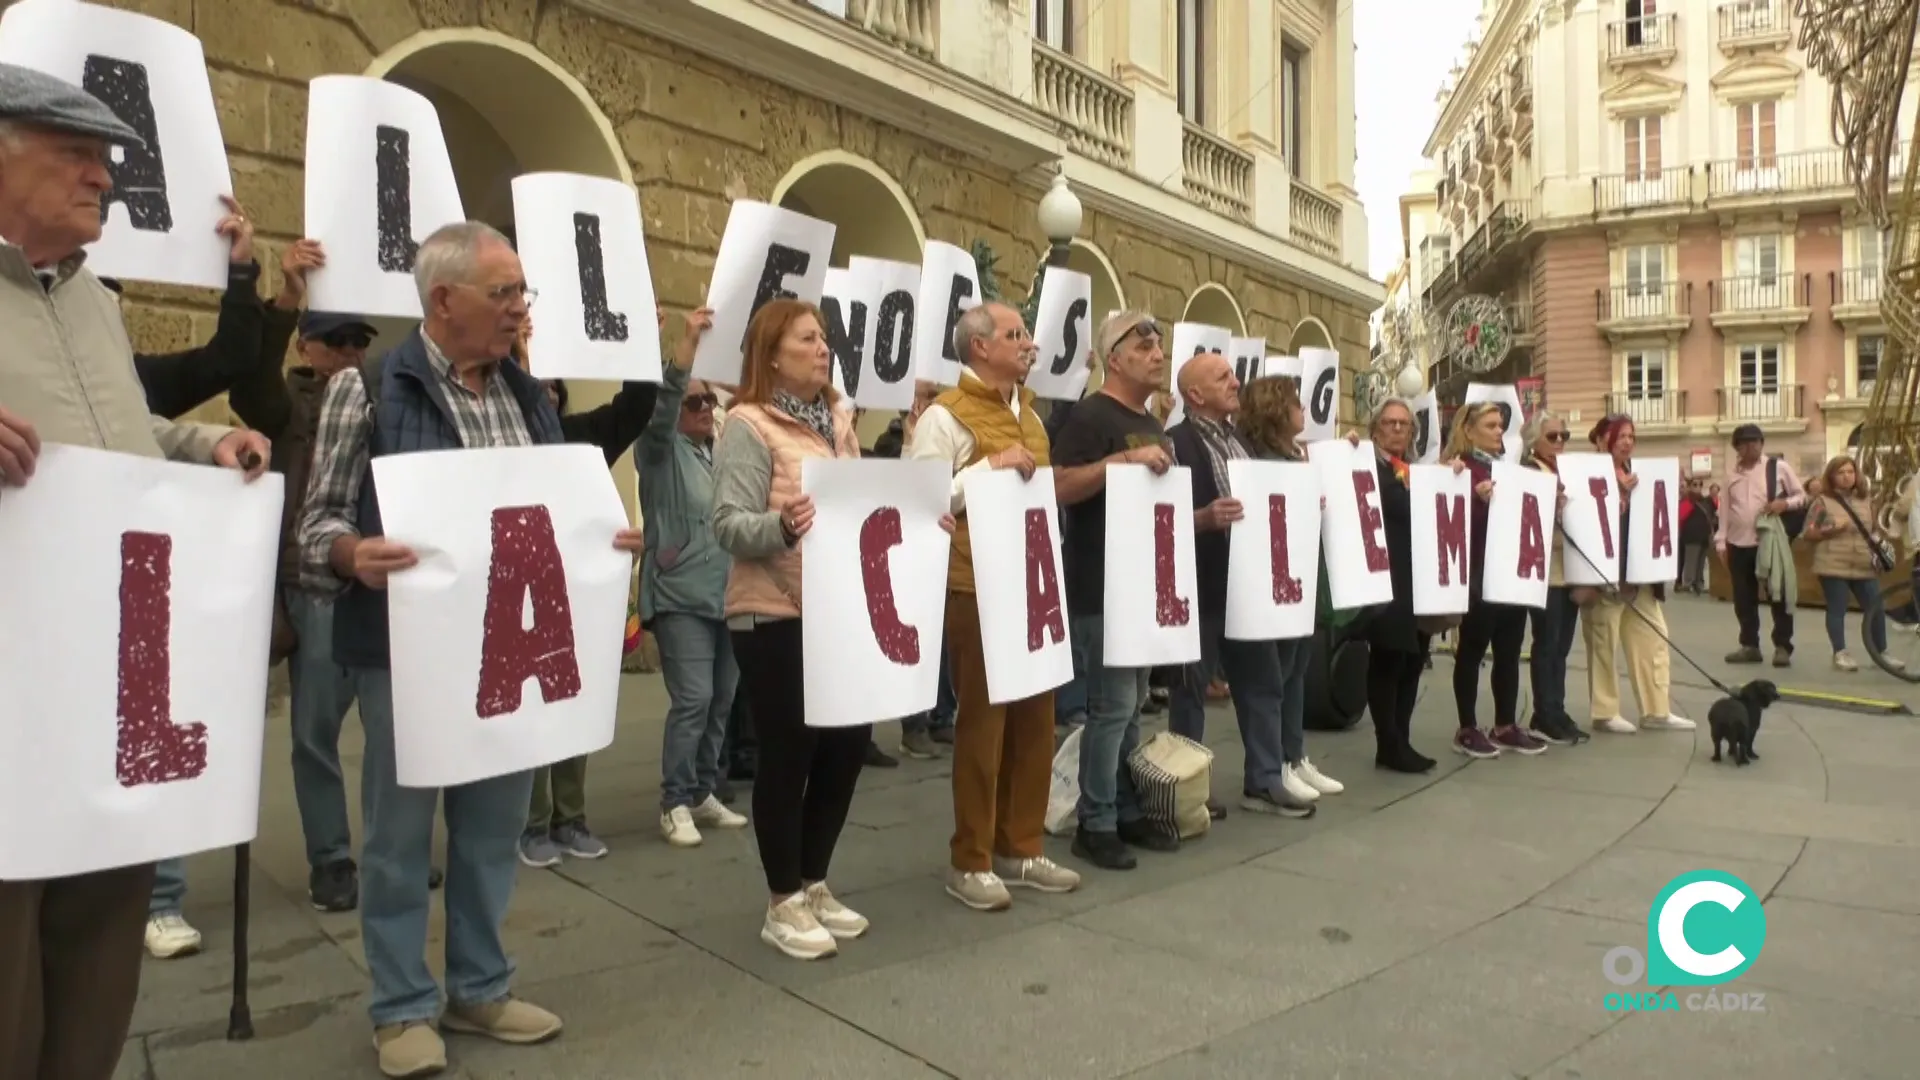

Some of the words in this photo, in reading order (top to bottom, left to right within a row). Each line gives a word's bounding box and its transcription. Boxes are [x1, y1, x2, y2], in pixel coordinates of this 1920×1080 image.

[376, 125, 420, 273] L
[573, 212, 628, 342] L
[873, 289, 915, 384] O
[1050, 297, 1088, 376] S
[1310, 366, 1337, 426] G
[1154, 503, 1190, 627] L
[1268, 493, 1303, 605] L
[1352, 469, 1389, 573] E
[1435, 492, 1467, 587] M
[1517, 492, 1545, 581] A
[1588, 476, 1614, 559] T
[1652, 479, 1673, 559] A
[475, 503, 581, 719] A
[859, 506, 920, 666] C
[1025, 507, 1066, 653] A
[116, 531, 208, 788] L
